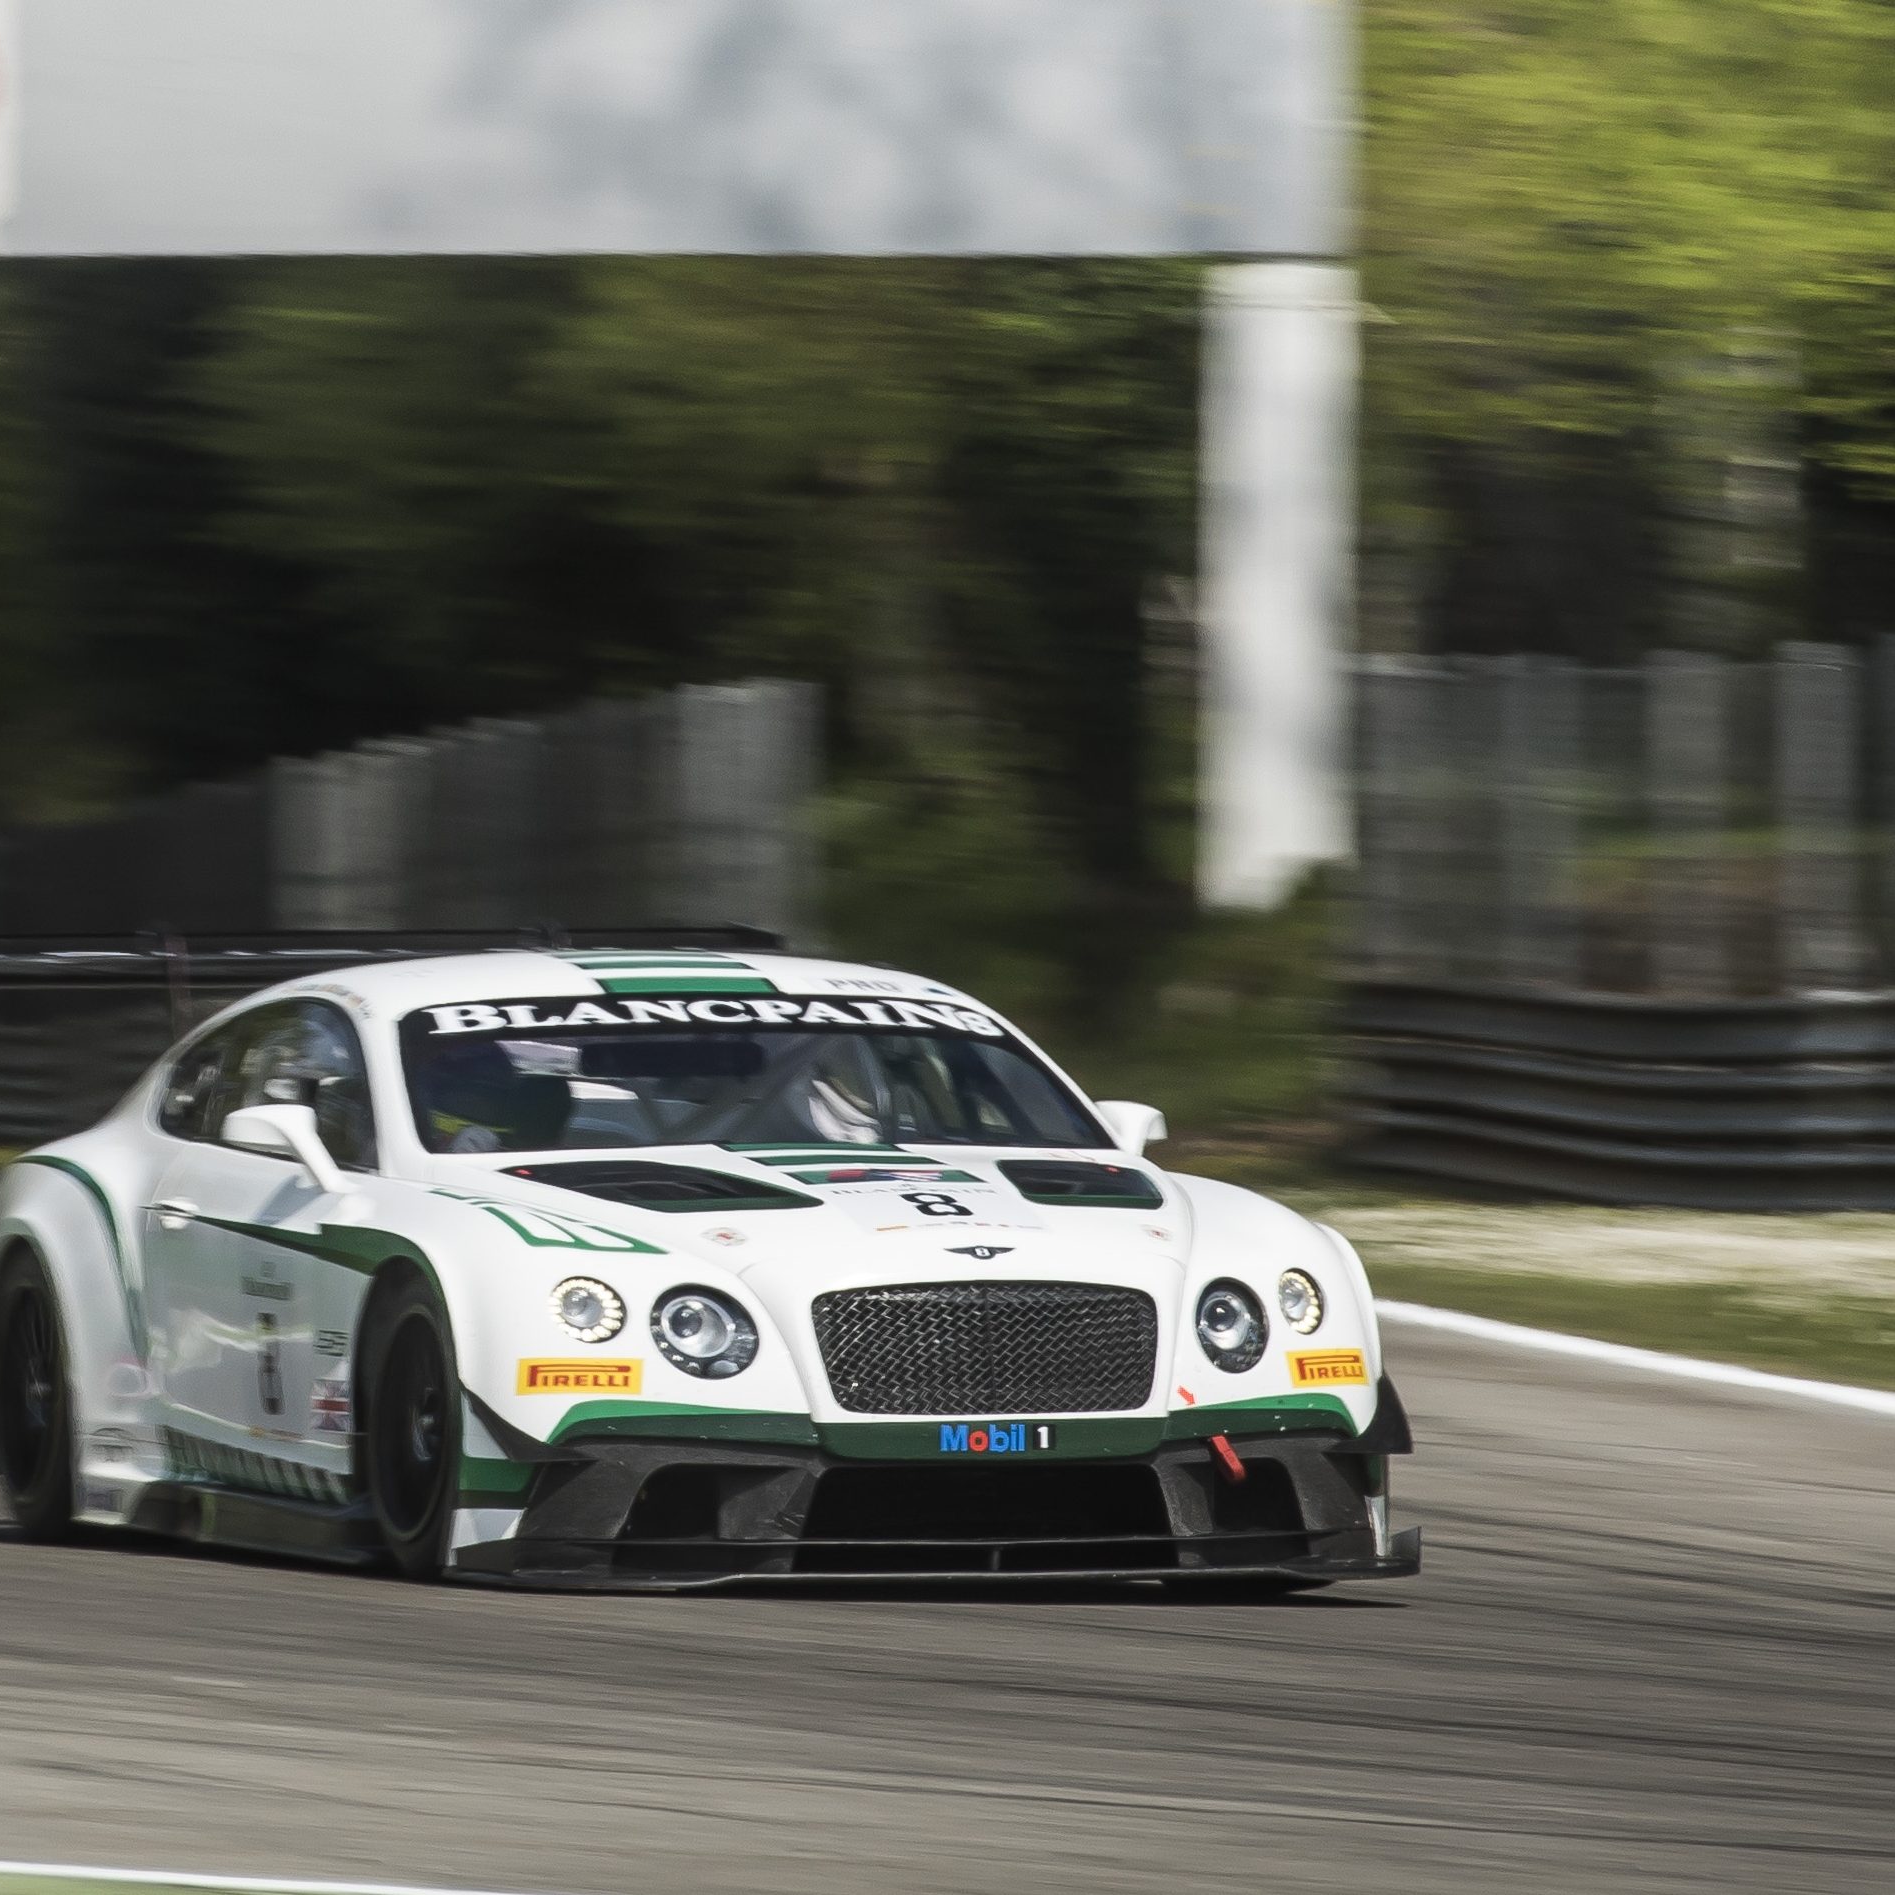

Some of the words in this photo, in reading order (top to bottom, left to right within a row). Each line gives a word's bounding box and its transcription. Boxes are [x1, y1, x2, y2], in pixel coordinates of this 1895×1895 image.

[421, 999, 971, 1035] BLANCPAIN
[900, 1192, 974, 1216] 8
[526, 1363, 631, 1388] PIRELLI
[1295, 1355, 1364, 1381] PIRELLI
[940, 1423, 1026, 1452] Mobil
[1037, 1426, 1049, 1449] 1
